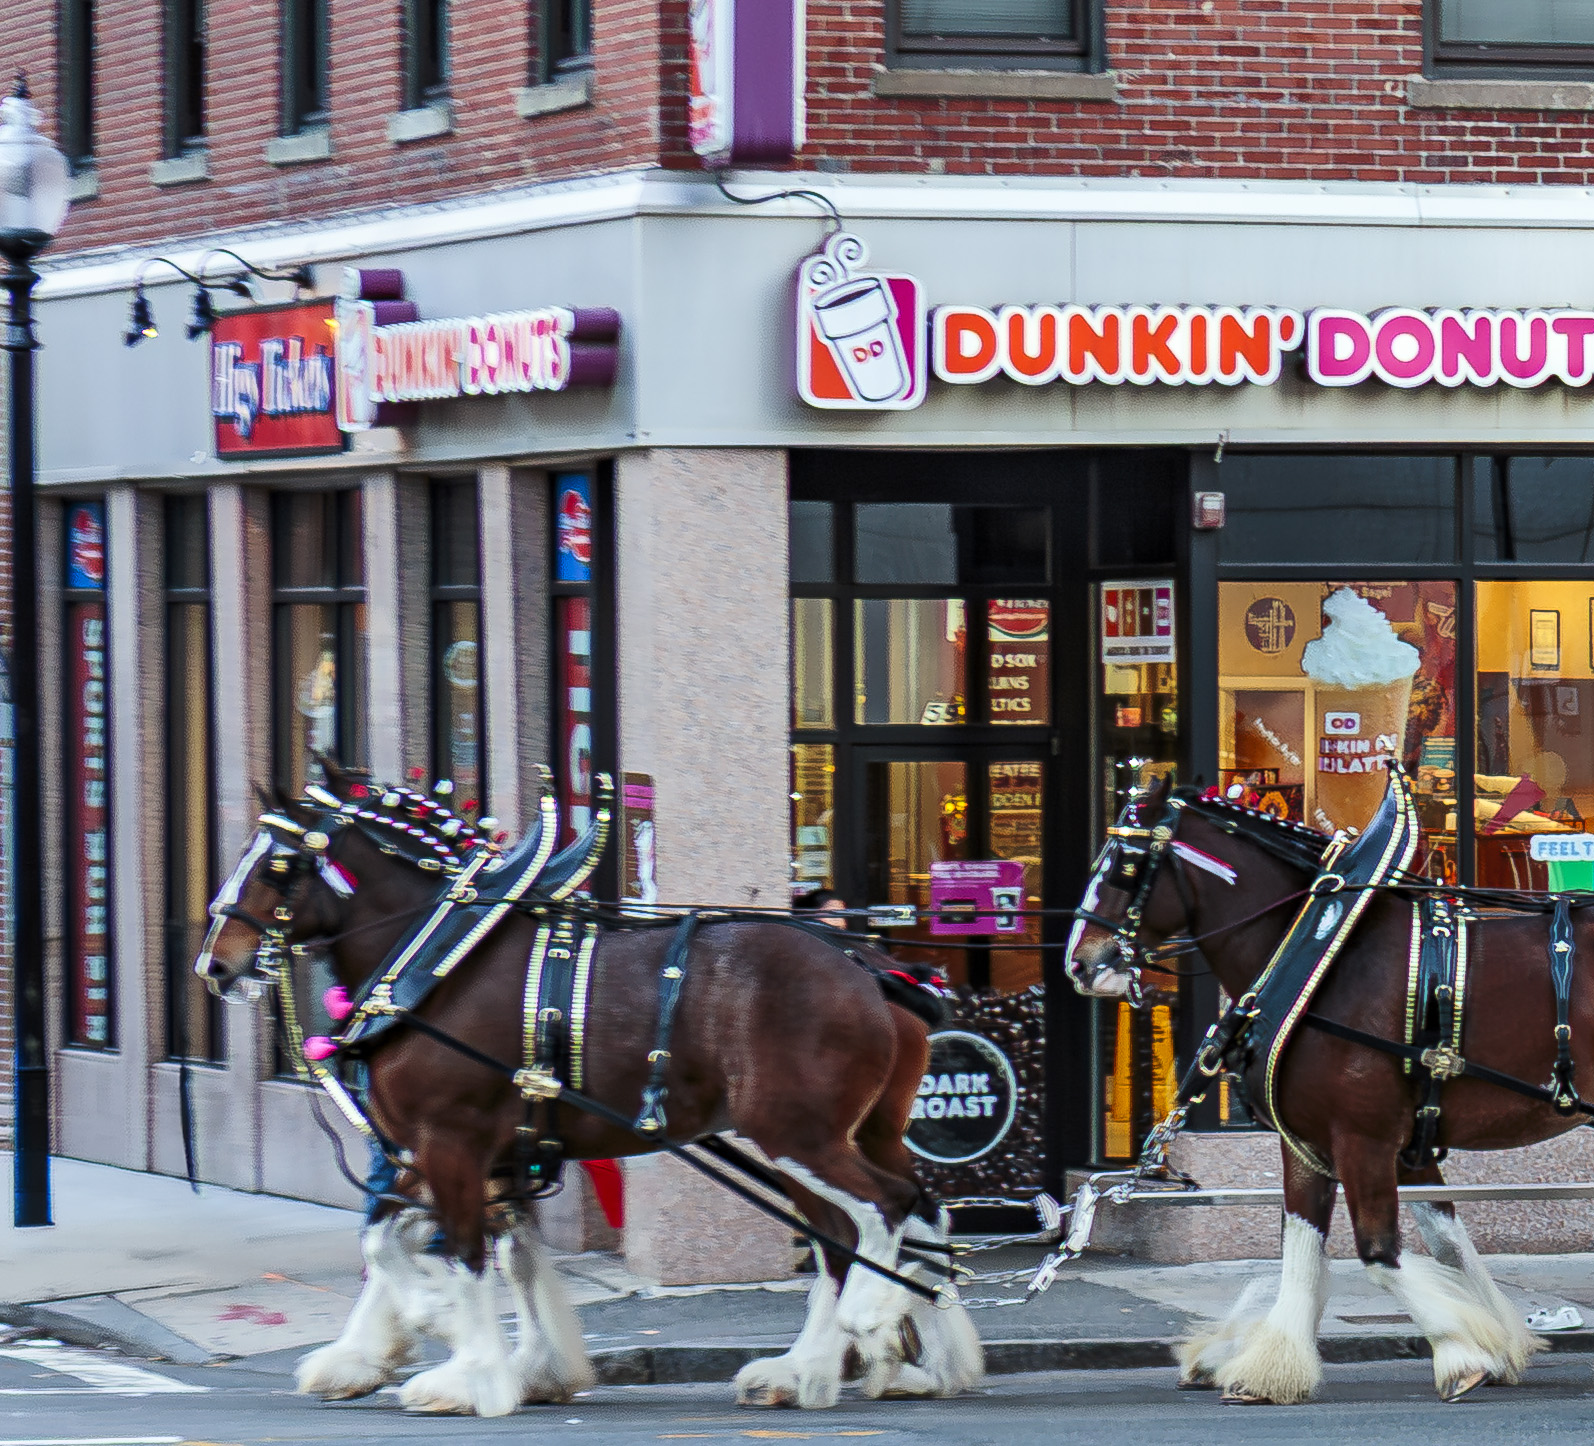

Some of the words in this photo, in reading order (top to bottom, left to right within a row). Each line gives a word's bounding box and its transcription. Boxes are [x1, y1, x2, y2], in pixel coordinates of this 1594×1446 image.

[940, 310, 1300, 380] DUNKIN'
[1537, 841, 1580, 857] FEEL
[916, 1073, 990, 1096] DARK
